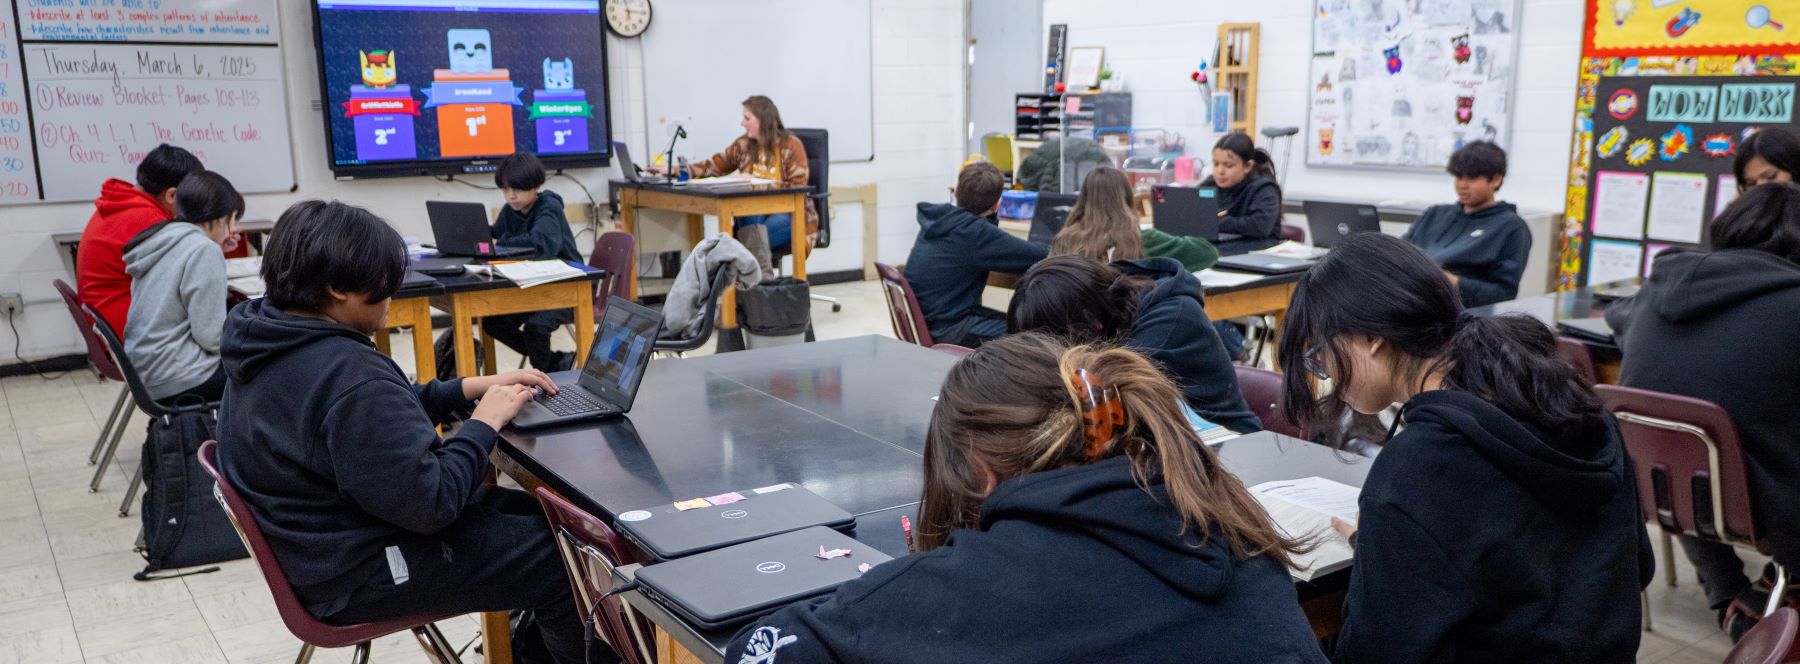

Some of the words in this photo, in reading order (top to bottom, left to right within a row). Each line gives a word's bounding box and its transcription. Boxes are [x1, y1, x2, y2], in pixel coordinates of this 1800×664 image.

[137, 50, 183, 76] March
[219, 56, 256, 77] 2025
[56, 86, 104, 108] Review
[176, 84, 211, 114] Pages
[1654, 89, 1712, 119] WOW
[1724, 87, 1792, 119] WORK
[87, 122, 101, 144] 4
[147, 121, 173, 142] The
[181, 122, 227, 143] Genetic
[233, 123, 261, 143] Code
